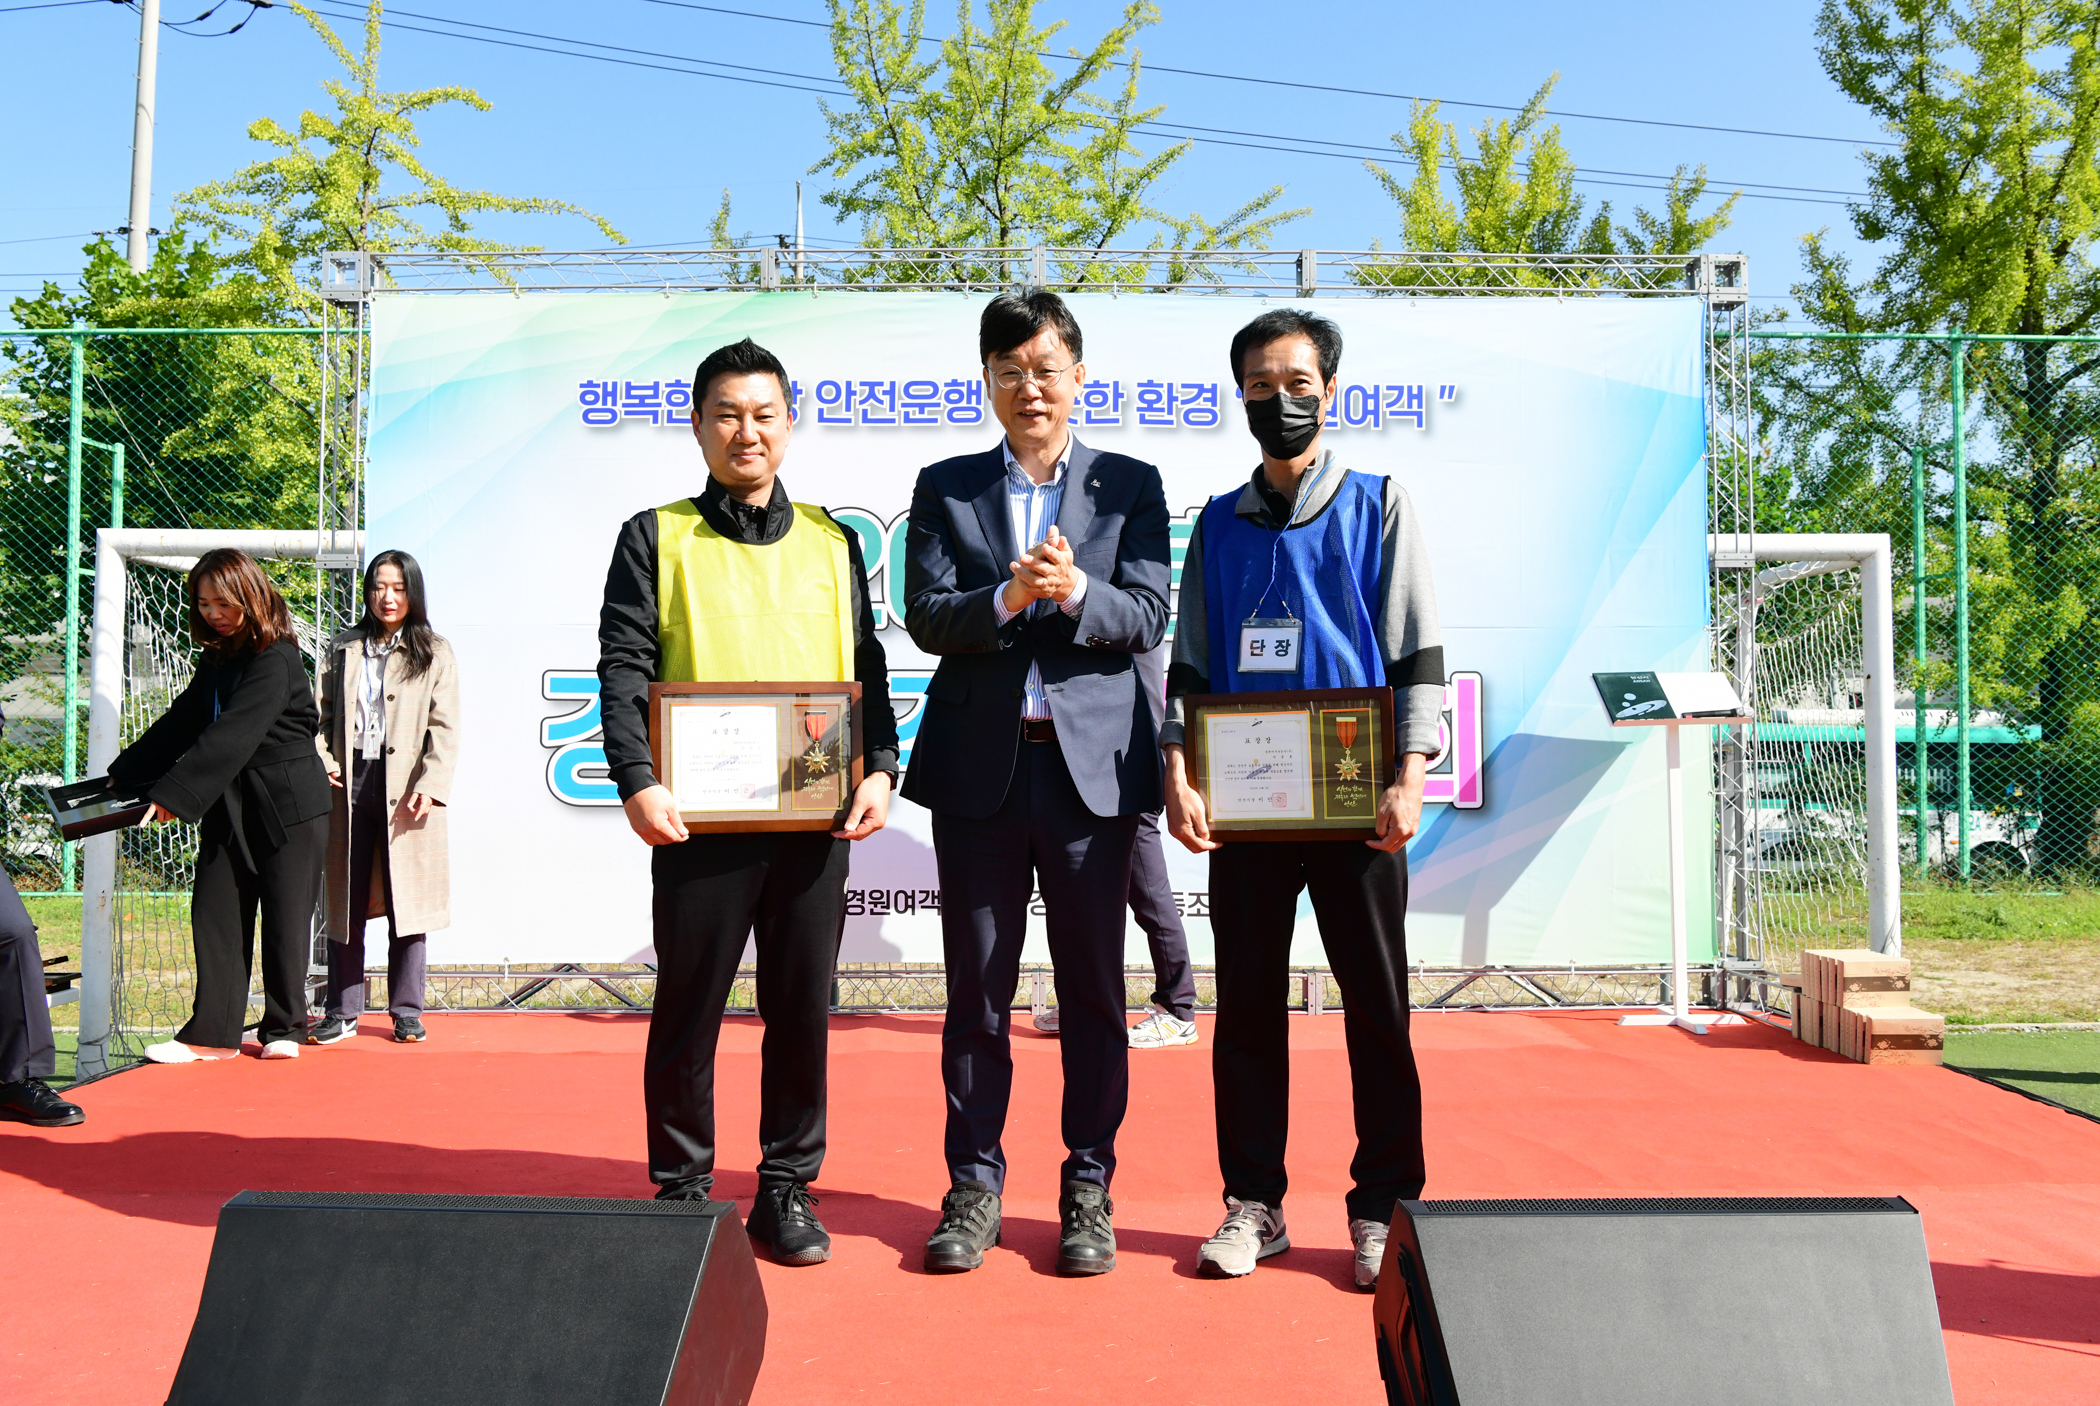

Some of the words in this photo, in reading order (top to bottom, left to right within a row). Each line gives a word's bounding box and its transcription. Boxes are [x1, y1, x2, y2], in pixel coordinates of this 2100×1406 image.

[815, 379, 983, 424] 안전운행
[1136, 379, 1220, 426] 환경
[846, 889, 941, 916] 경원여객
